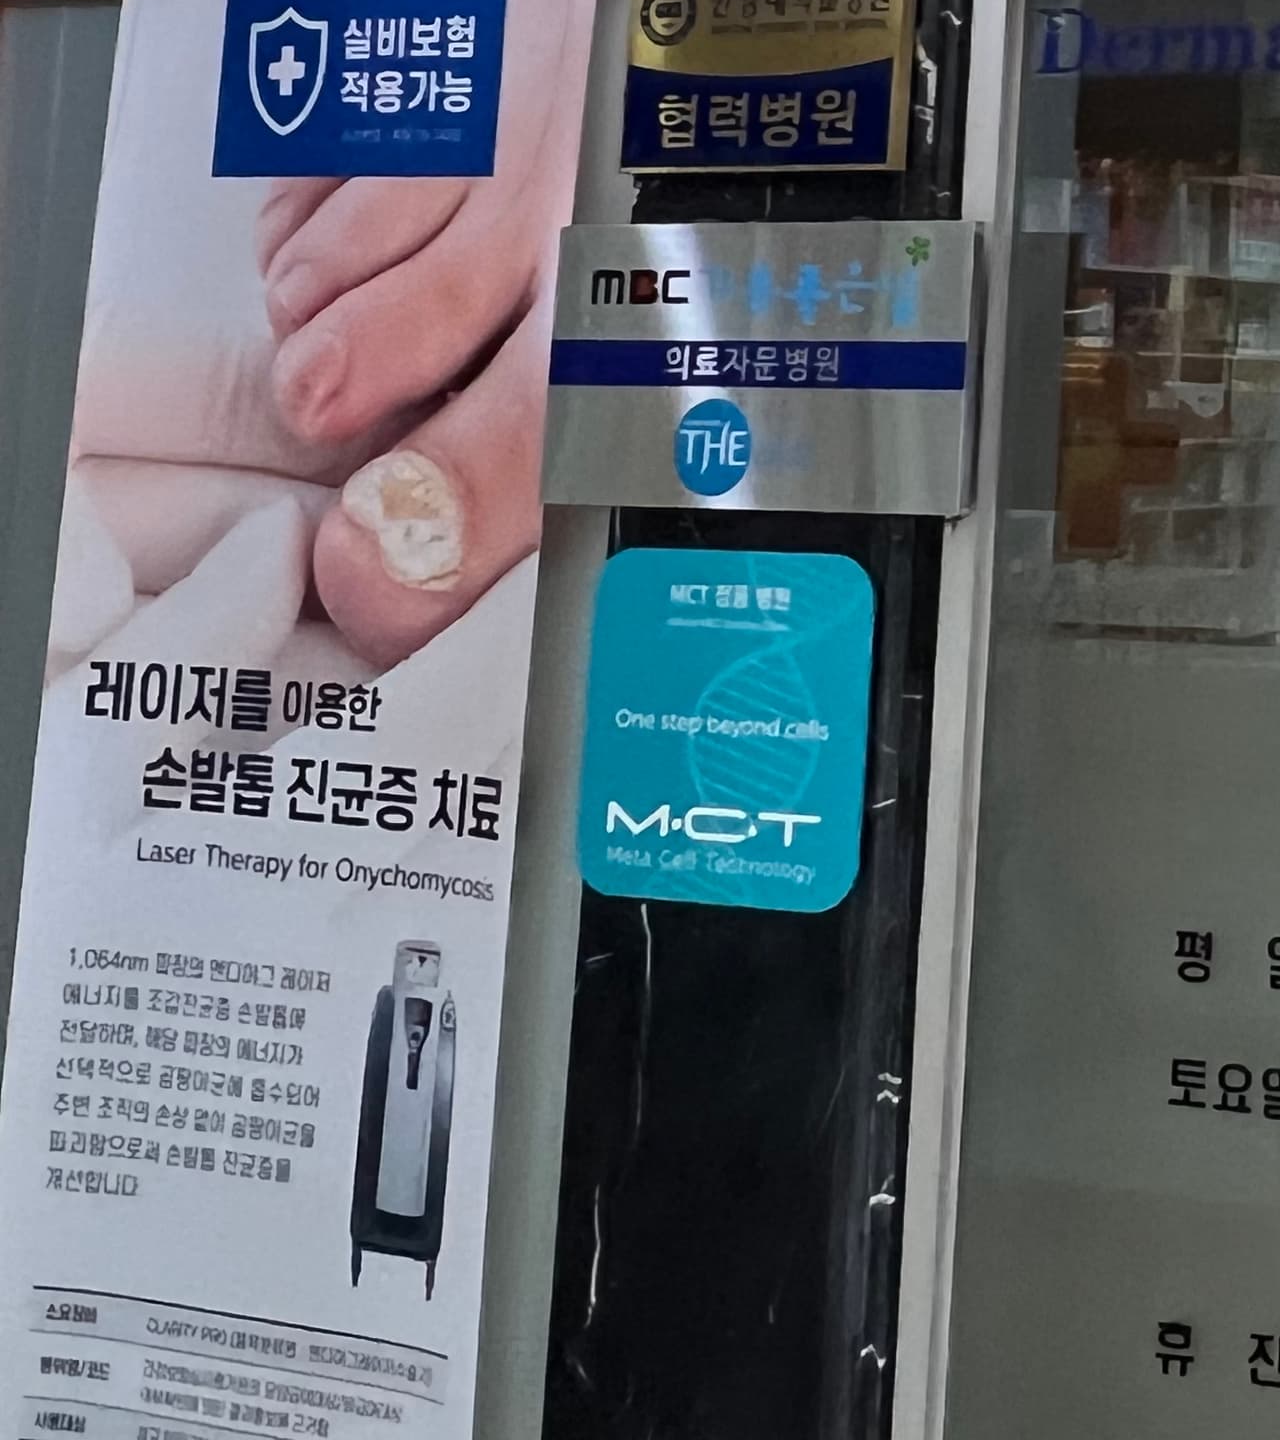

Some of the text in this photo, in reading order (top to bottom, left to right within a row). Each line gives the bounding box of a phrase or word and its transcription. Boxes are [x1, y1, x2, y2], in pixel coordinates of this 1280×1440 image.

[343, 15, 477, 60] 실비보험
[340, 70, 473, 113] 적용가능
[658, 89, 856, 148] 협력병원
[591, 269, 691, 305] MBC
[664, 345, 839, 383] 의료자문병원
[679, 421, 748, 474] THE
[84, 660, 382, 733] 레이저를 이용한
[615, 707, 655, 730] One
[661, 713, 701, 735] step
[706, 715, 780, 738] beyond
[142, 747, 502, 841] 손발톱 진균증 치료
[136, 837, 196, 865] Laser
[204, 843, 293, 883] Therapy
[298, 853, 329, 881] for
[606, 845, 652, 868] Meta
[706, 851, 816, 885] Technology
